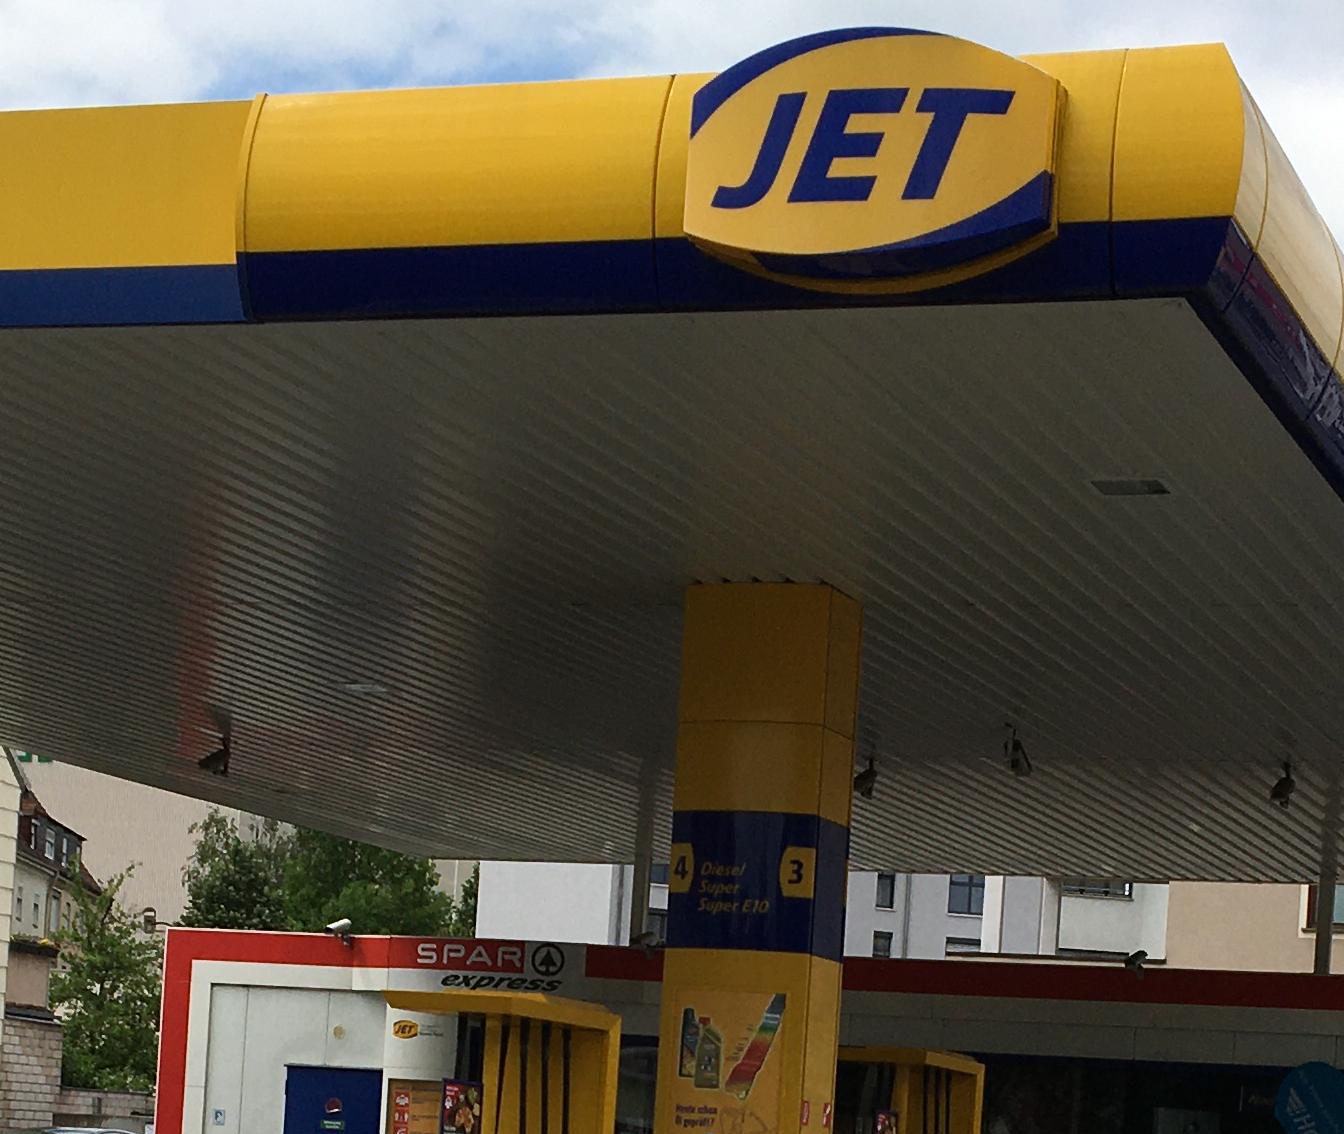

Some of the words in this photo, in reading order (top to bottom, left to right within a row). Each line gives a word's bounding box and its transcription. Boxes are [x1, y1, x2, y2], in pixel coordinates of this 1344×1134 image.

[711, 87, 1015, 209] JET
[673, 855, 689, 881] 4
[700, 861, 747, 877] Diesel
[786, 859, 805, 885] 3
[698, 880, 740, 897] Super
[697, 899, 739, 914] Super
[741, 900, 771, 914] E10
[416, 942, 523, 968] SPAR
[440, 973, 564, 992] express
[393, 1022, 415, 1036] JET
